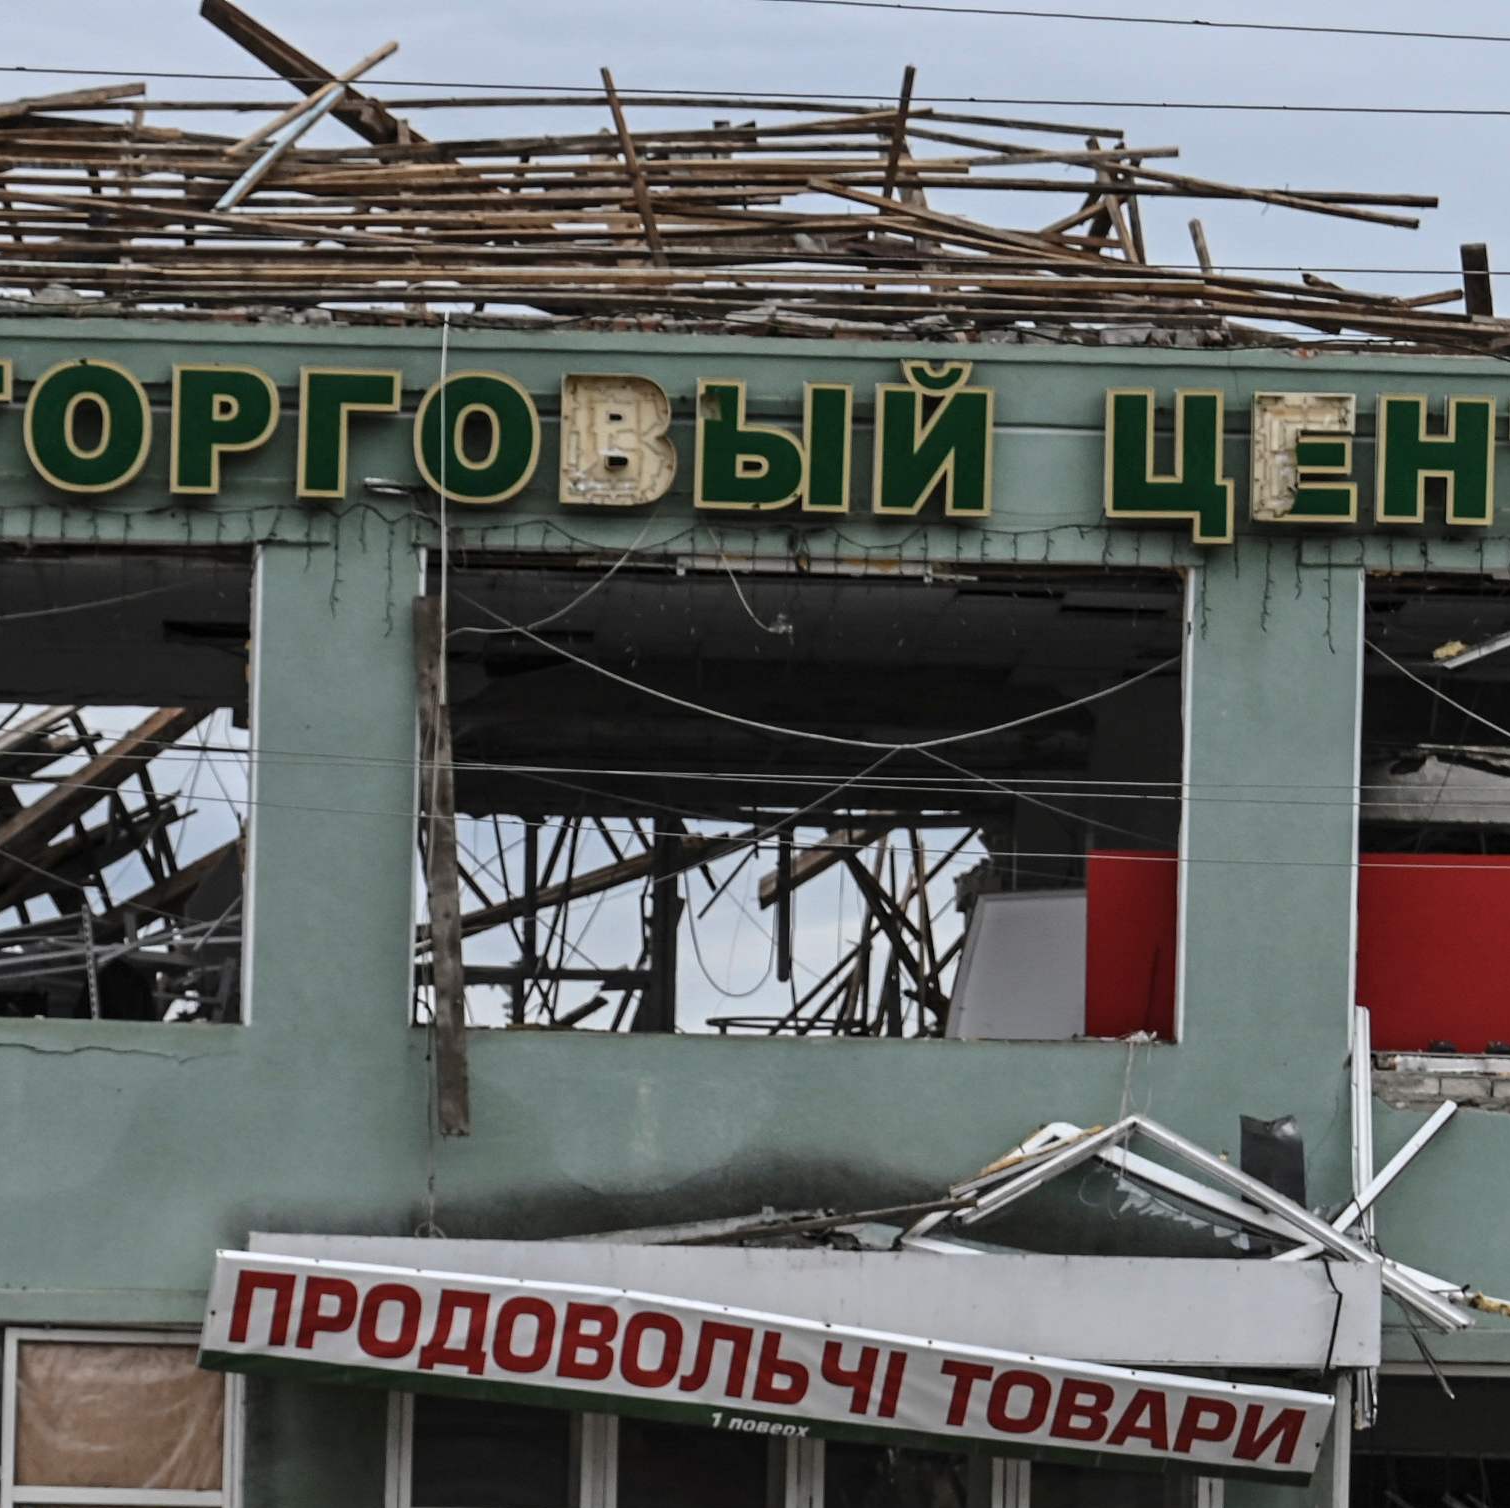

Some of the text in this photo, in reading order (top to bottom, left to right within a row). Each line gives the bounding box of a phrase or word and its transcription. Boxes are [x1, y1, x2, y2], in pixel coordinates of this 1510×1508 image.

[228, 1269, 1308, 1465] ПРОДОВОЛЬЧІ ТОВАРИ
[711, 1412, 809, 1438] 1 поверх
